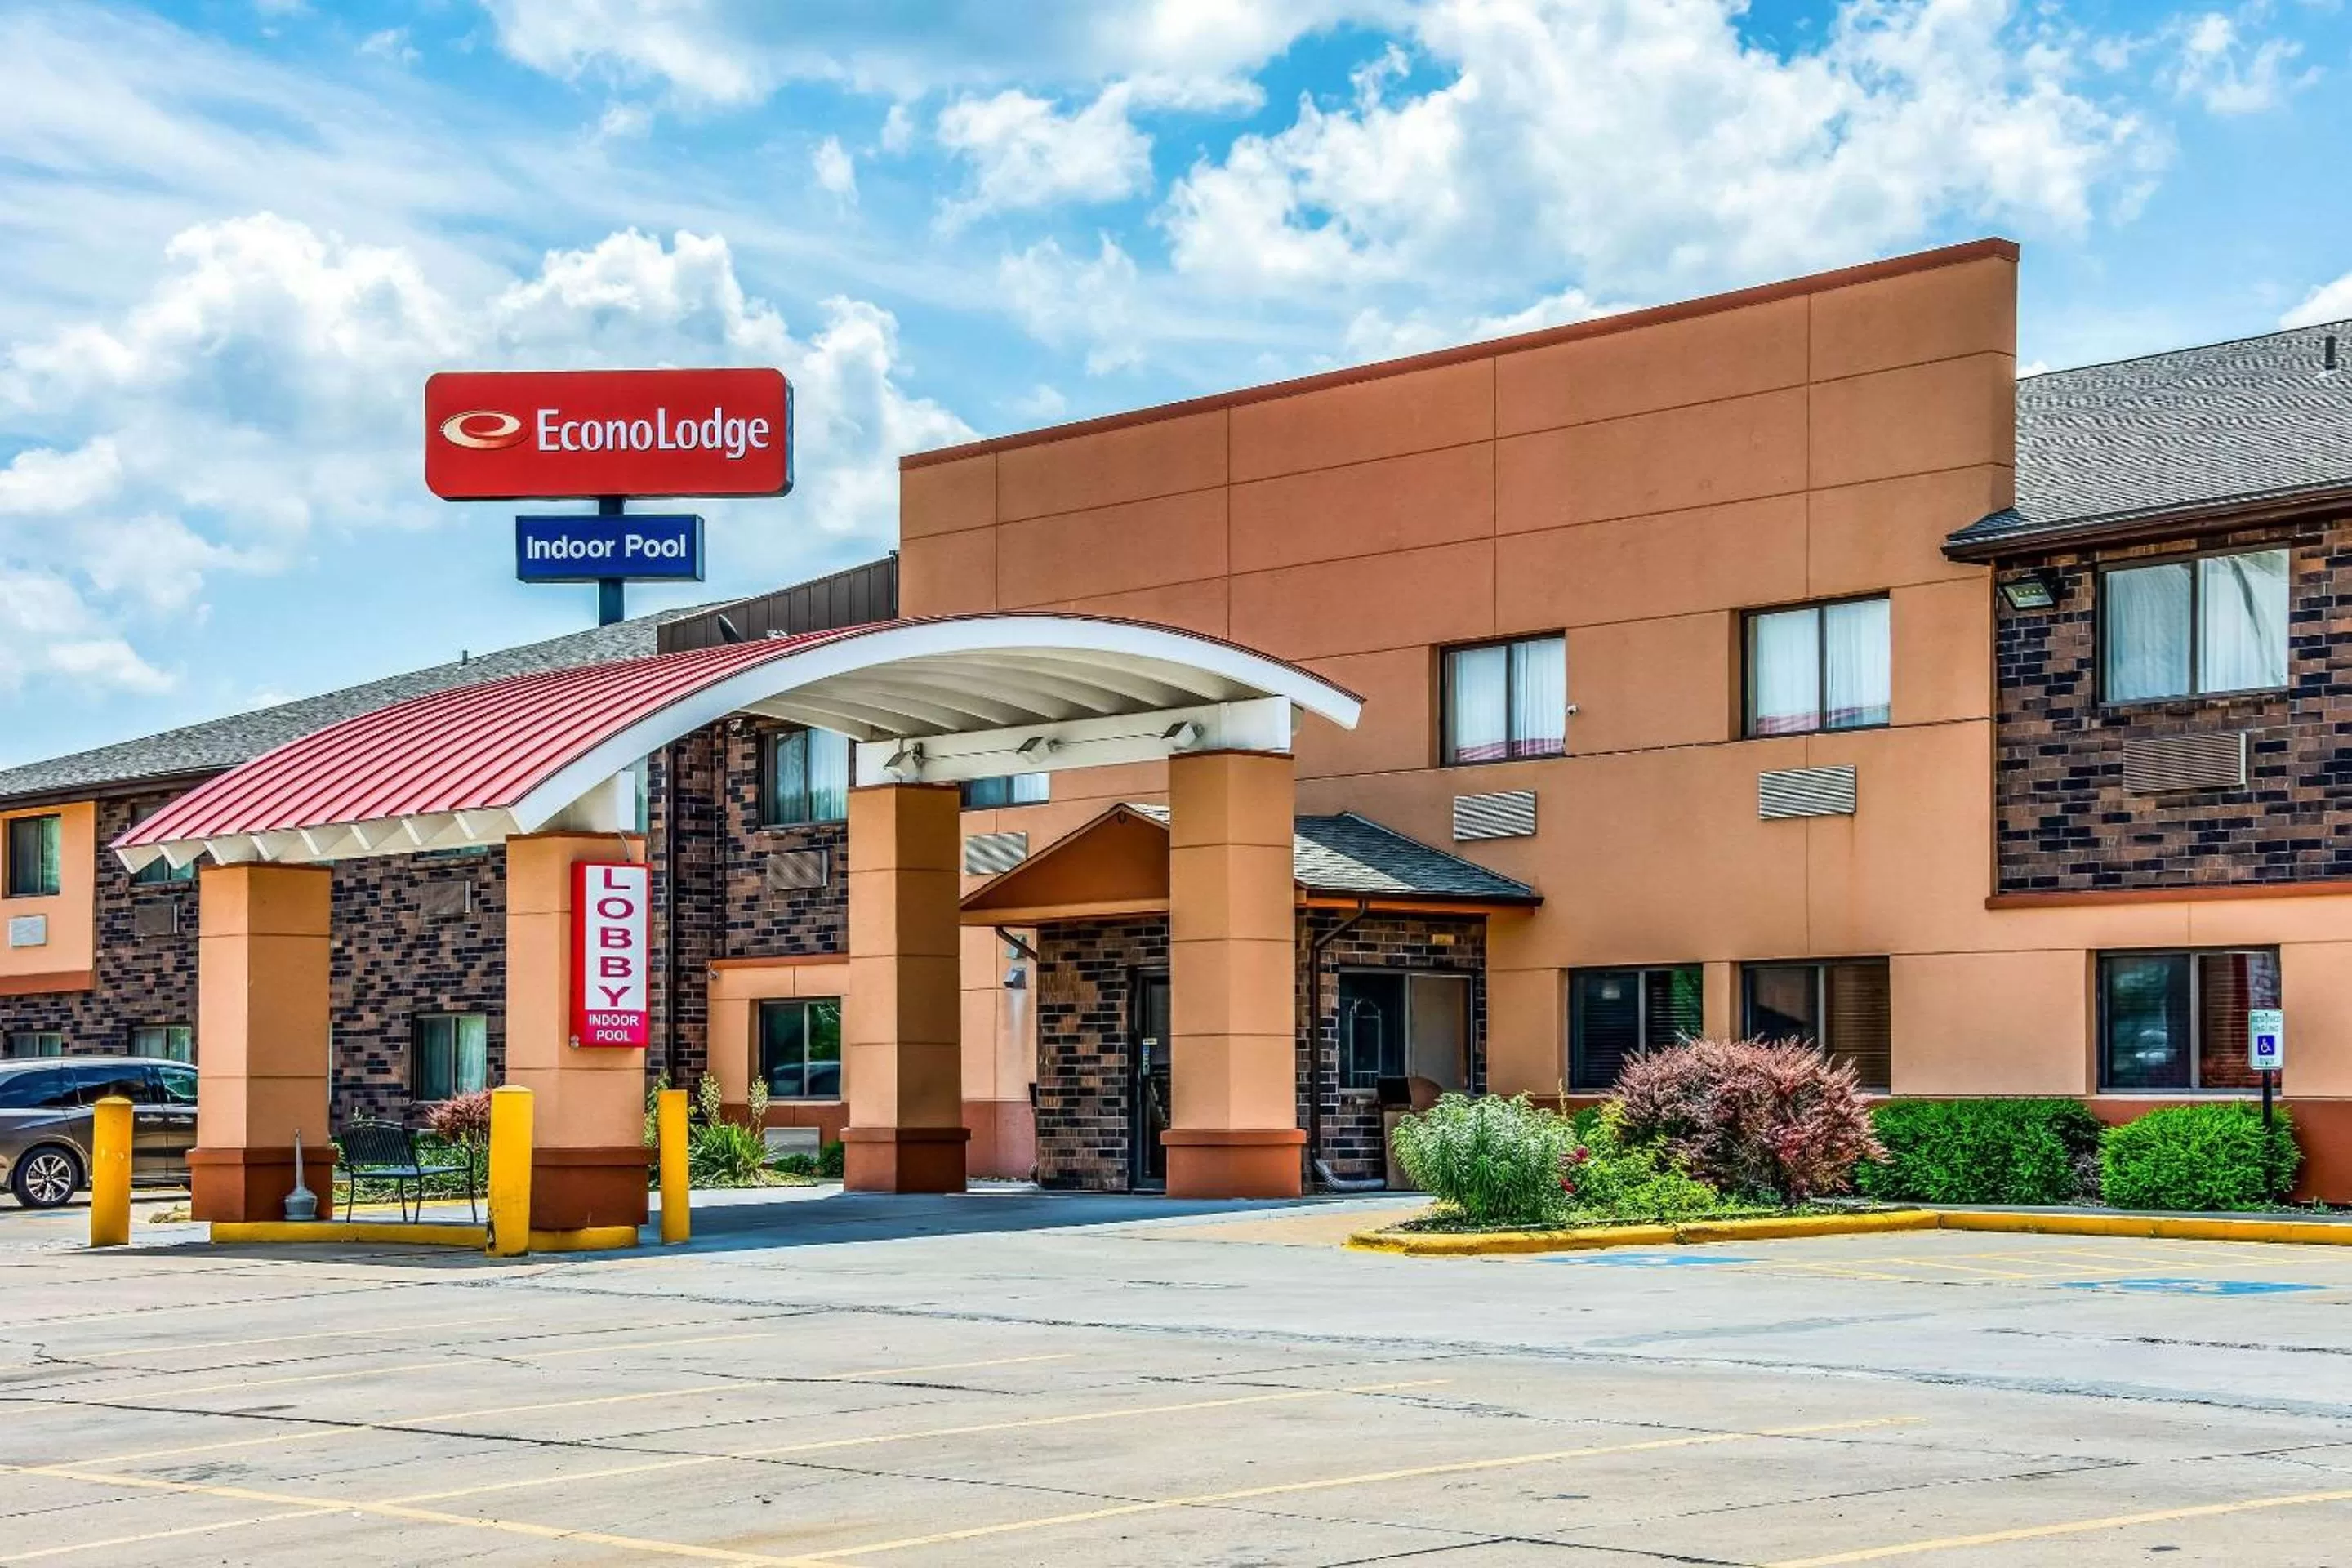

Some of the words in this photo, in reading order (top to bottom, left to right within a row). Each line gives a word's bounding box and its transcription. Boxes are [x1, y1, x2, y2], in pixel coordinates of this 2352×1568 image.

[537, 407, 770, 460] EconoLodge
[526, 536, 615, 559] Indoor
[625, 534, 687, 559] Pool
[596, 867, 635, 1008] LOBBY
[589, 1013, 639, 1027] INDOOR
[596, 1029, 632, 1042] POOL
